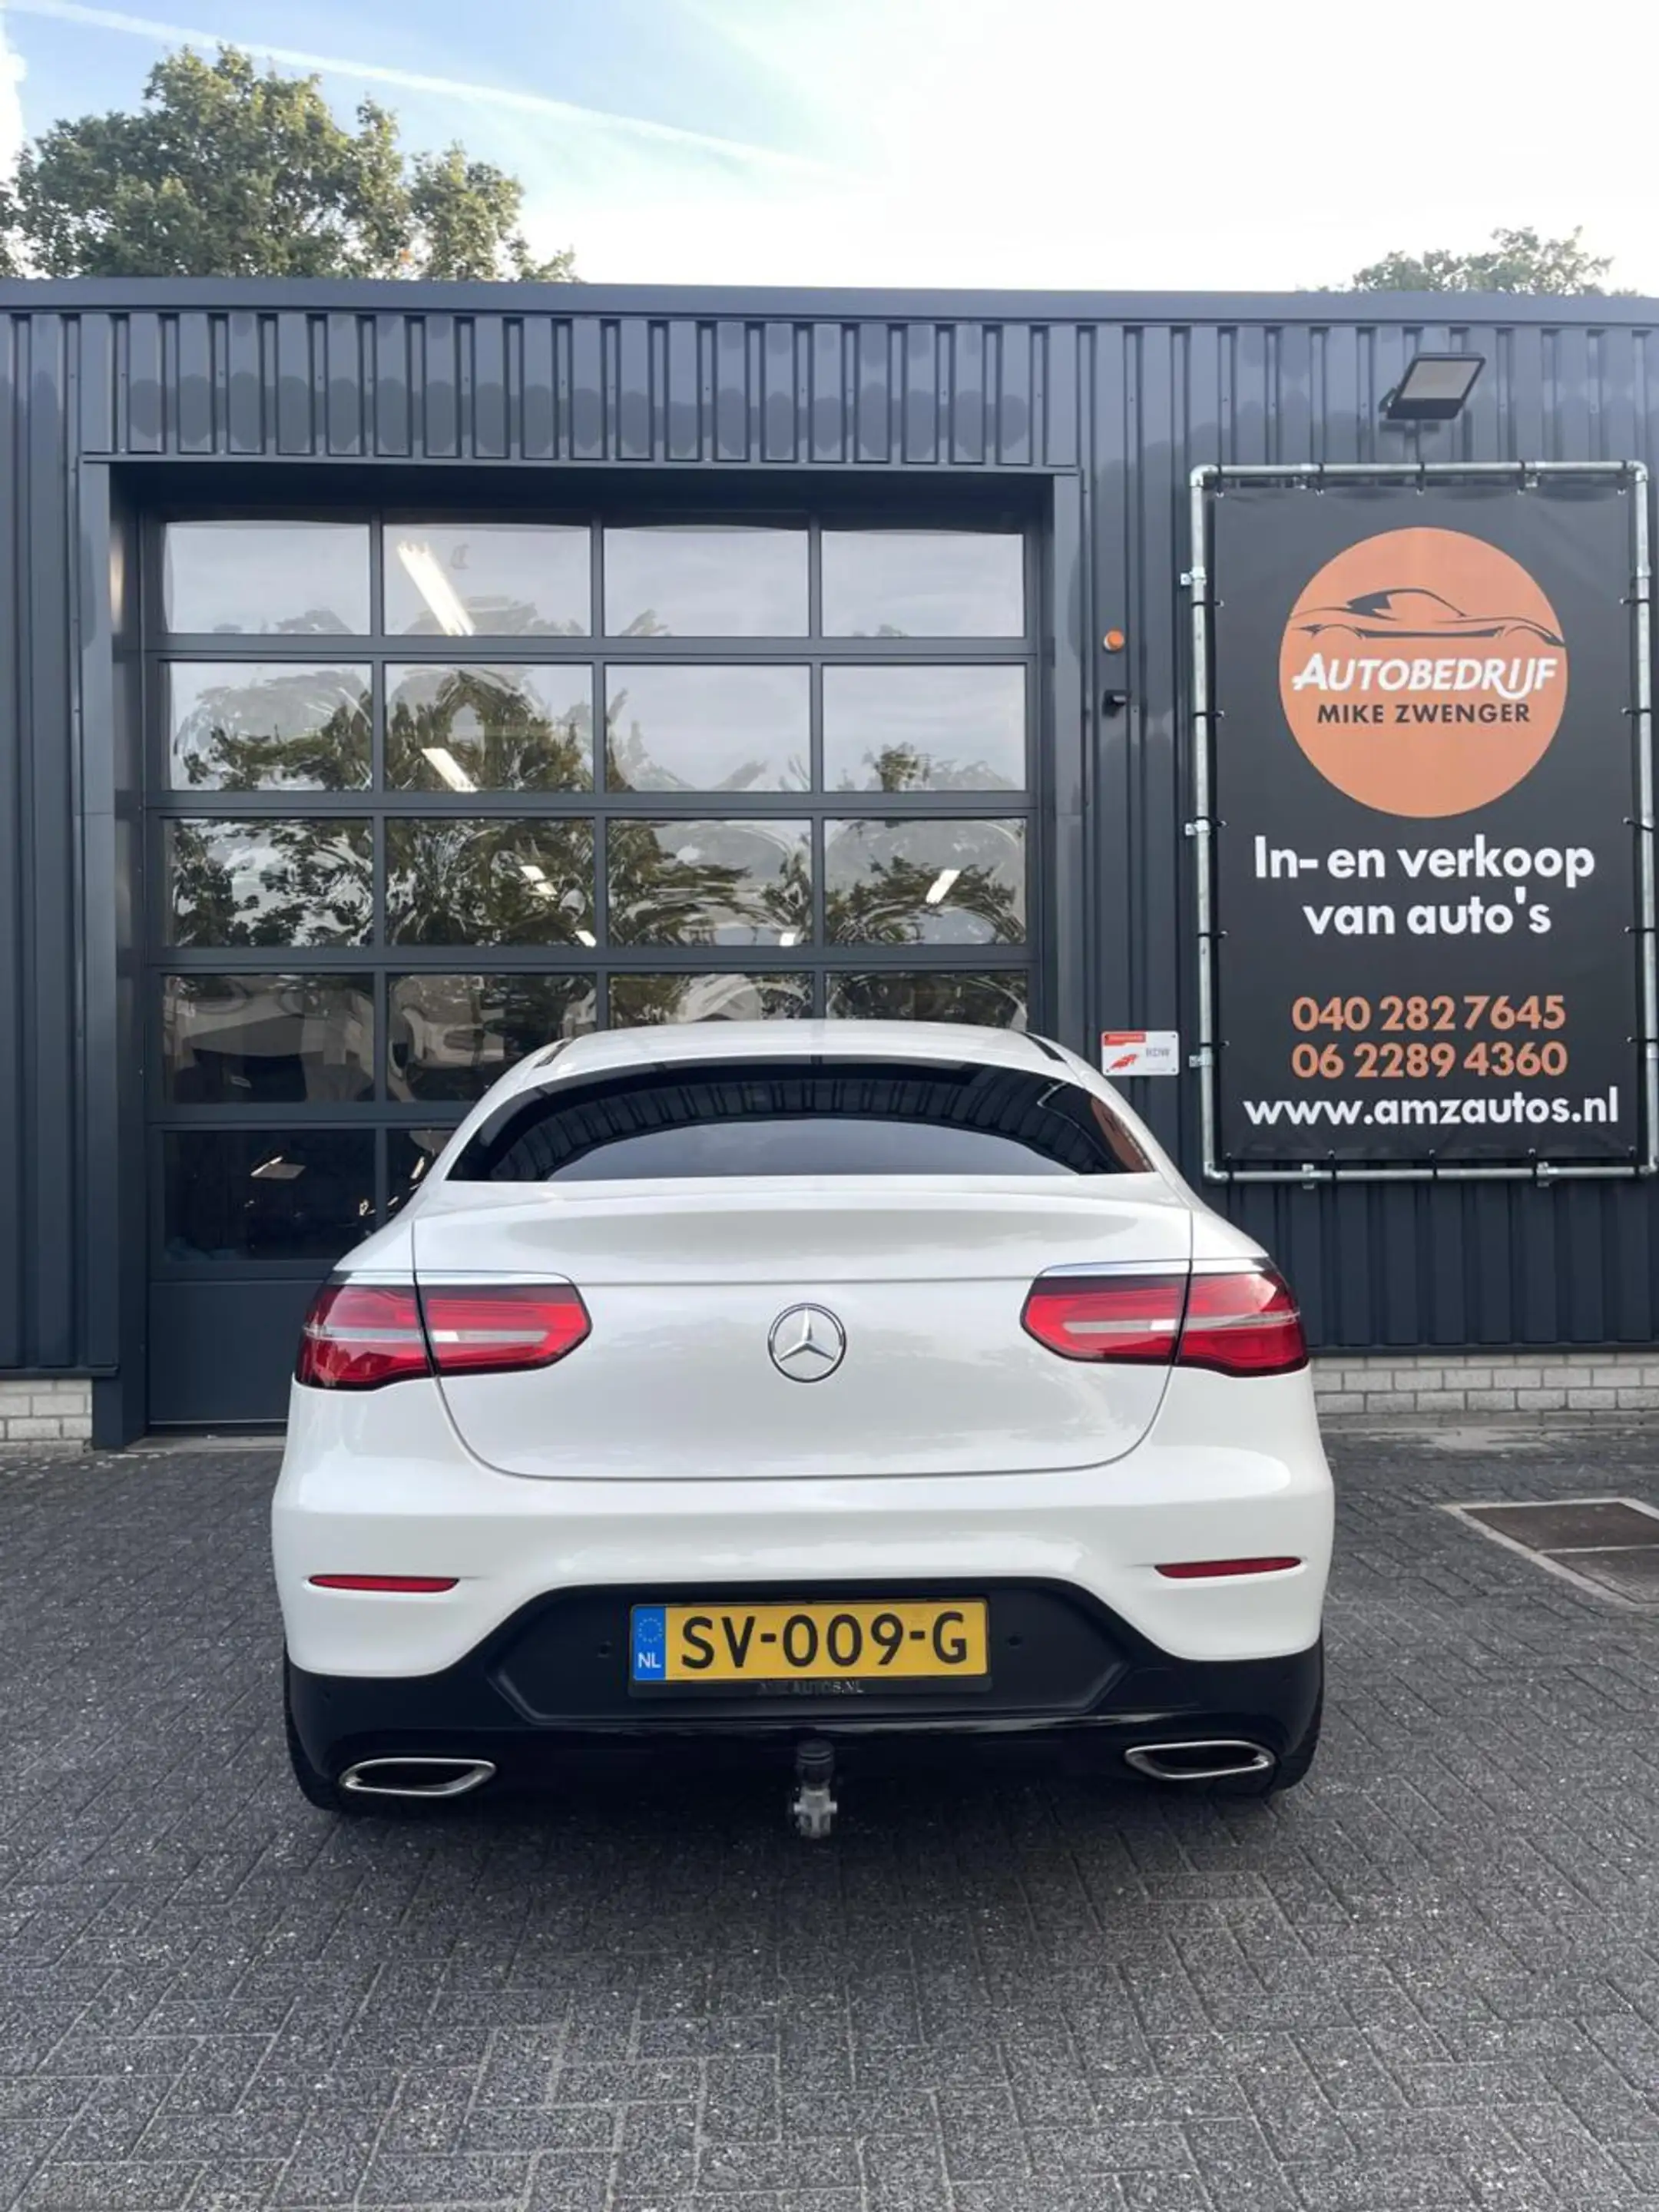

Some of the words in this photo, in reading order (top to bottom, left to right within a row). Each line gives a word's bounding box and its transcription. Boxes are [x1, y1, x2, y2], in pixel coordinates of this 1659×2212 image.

[1292, 652, 1558, 700] AUTOBEDRIJF
[1317, 704, 1384, 724] MIKE
[1395, 703, 1530, 724] ZWENGER
[1254, 836, 1319, 878] In-
[1326, 849, 1386, 878] en
[1396, 834, 1595, 889] verkoop
[1303, 905, 1395, 935] van
[1406, 886, 1551, 935] auto's
[1292, 996, 1372, 1031] 040
[1379, 995, 1455, 1031] 282
[1465, 995, 1566, 1031] 7645
[1292, 1044, 1345, 1078] 06
[1353, 1043, 1456, 1078] 2289
[1463, 1041, 1568, 1077] 4360
[1243, 1086, 1619, 1125] www.amzautos.nl
[637, 1651, 661, 1668] NL
[681, 1611, 967, 1670] SV-009-G
